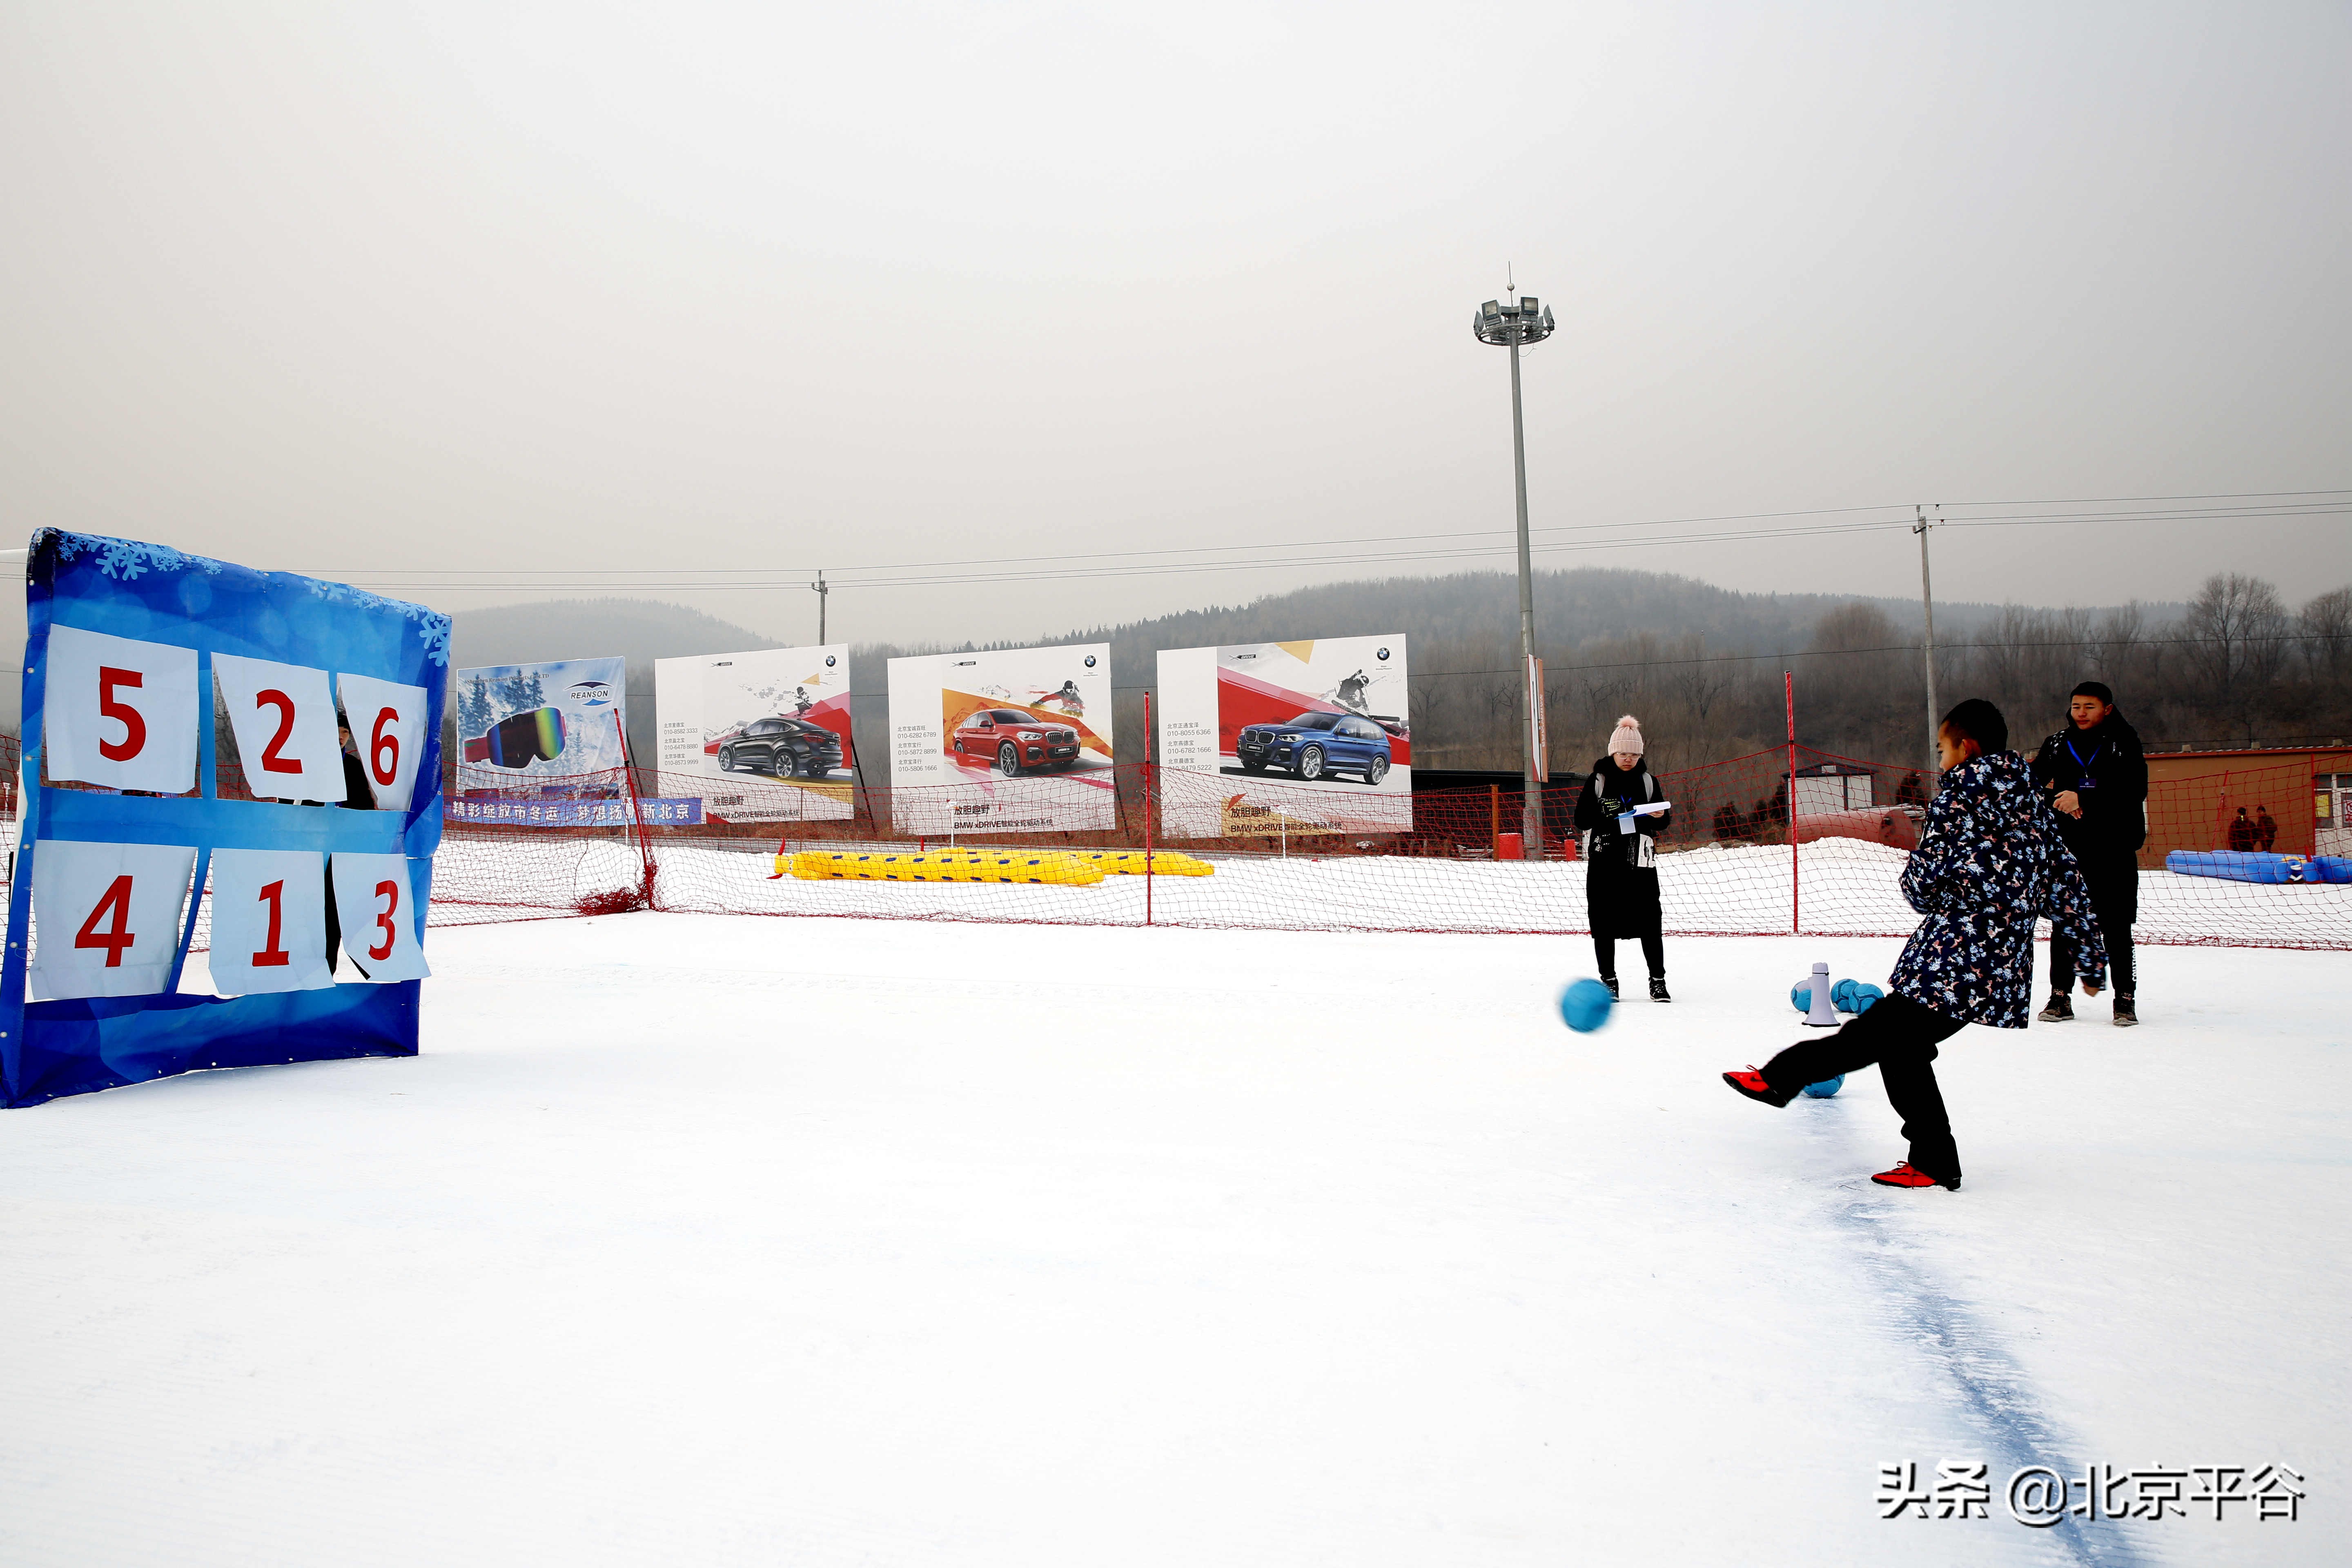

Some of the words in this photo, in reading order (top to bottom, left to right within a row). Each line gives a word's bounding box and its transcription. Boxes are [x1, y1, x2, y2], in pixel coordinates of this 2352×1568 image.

[100, 666, 146, 761] 5
[257, 689, 303, 774] 2
[571, 690, 608, 699] REANSON
[371, 706, 399, 786] 6
[713, 797, 744, 806] 放胆趣野
[954, 804, 989, 815] 放胆趣野
[1231, 806, 1271, 817] 放胆趣野
[76, 875, 134, 968] 4
[252, 880, 289, 967] 1
[369, 880, 399, 961] 3
